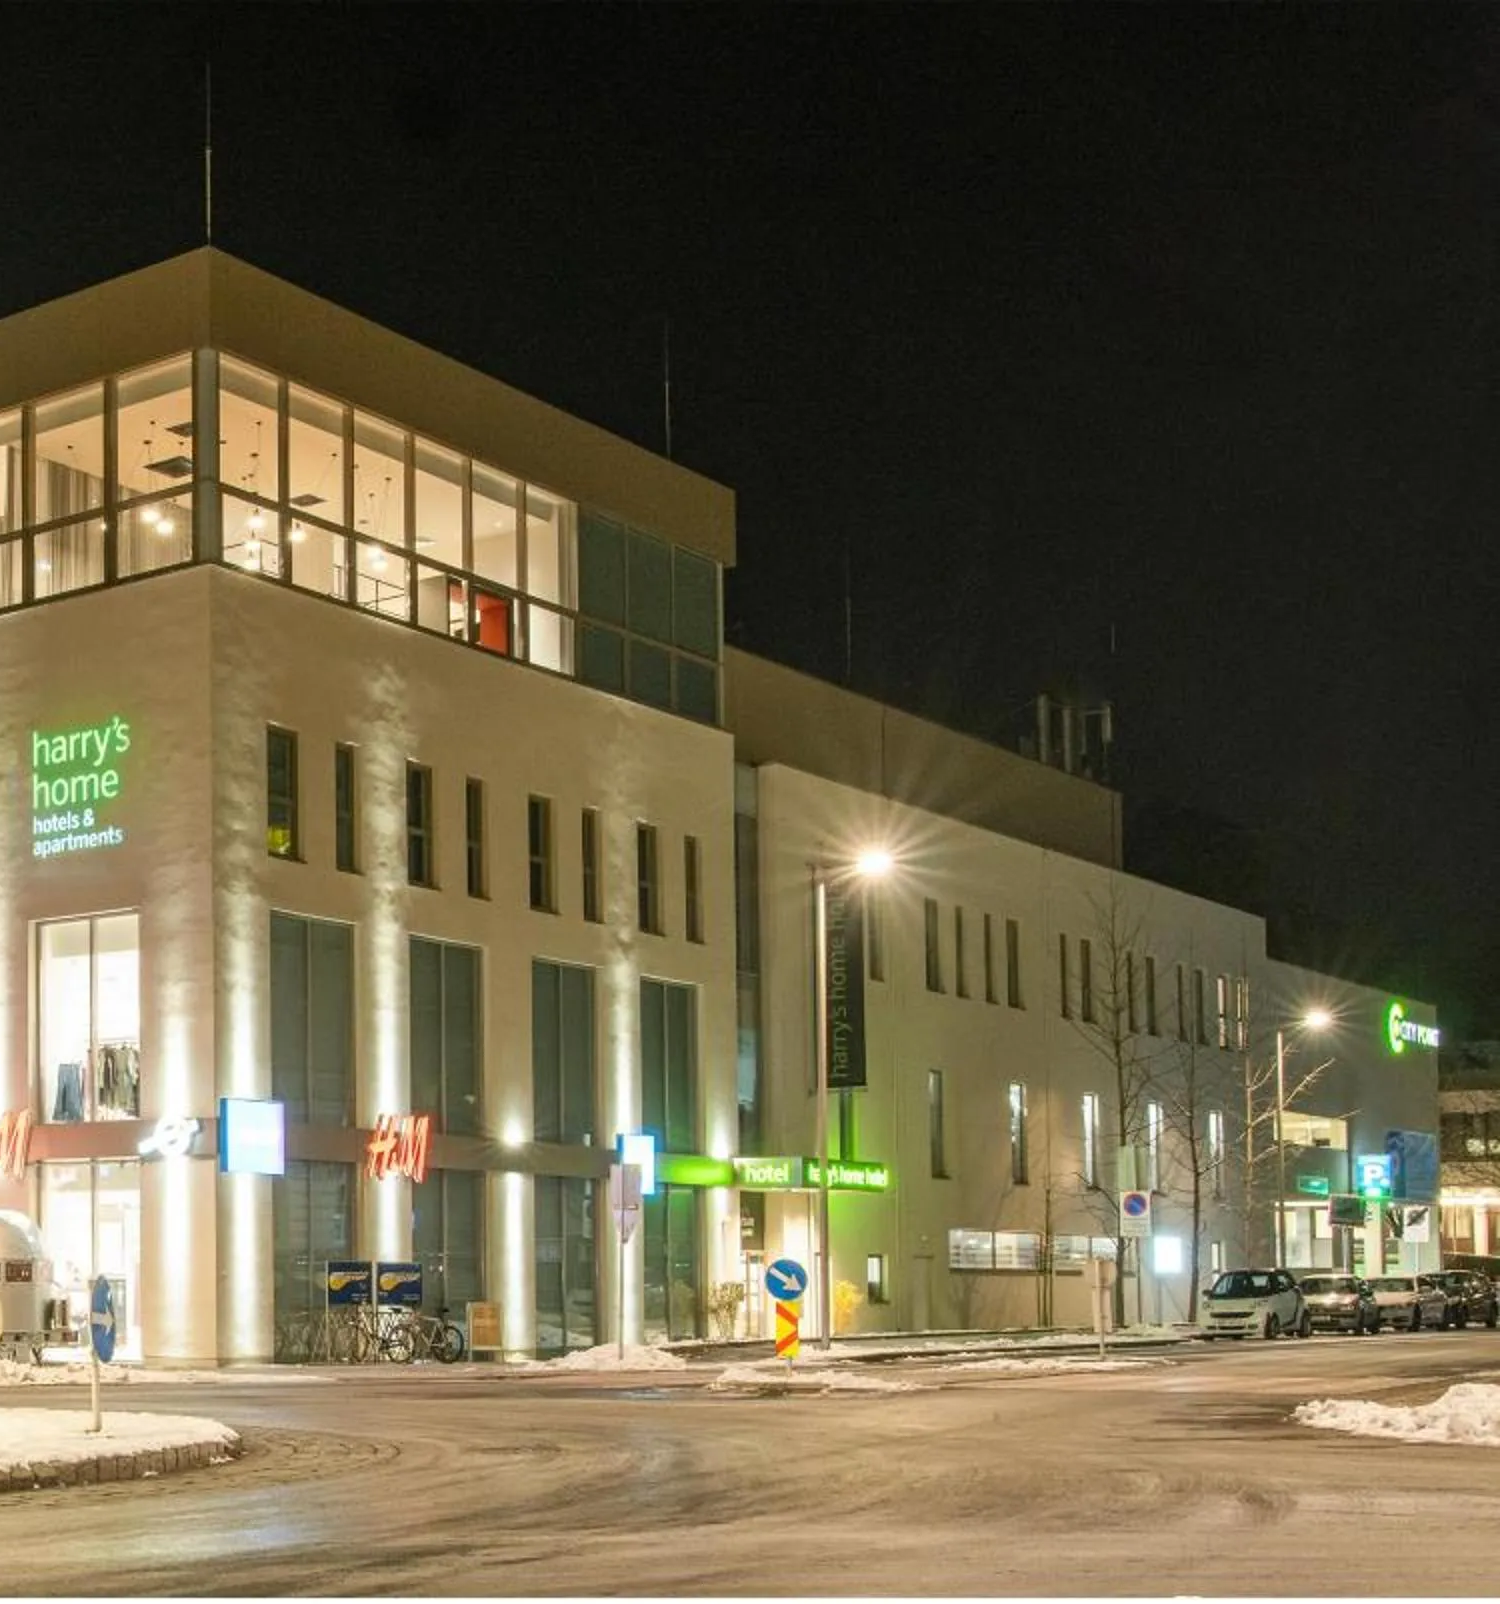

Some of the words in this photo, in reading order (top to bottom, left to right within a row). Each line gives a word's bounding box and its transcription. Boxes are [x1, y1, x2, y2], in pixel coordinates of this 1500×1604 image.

[33, 716, 130, 768] harry's
[33, 769, 119, 810] home
[33, 811, 80, 835] hotels
[83, 808, 95, 827] &
[33, 825, 124, 859] apartments
[745, 1163, 789, 1184] hotel
